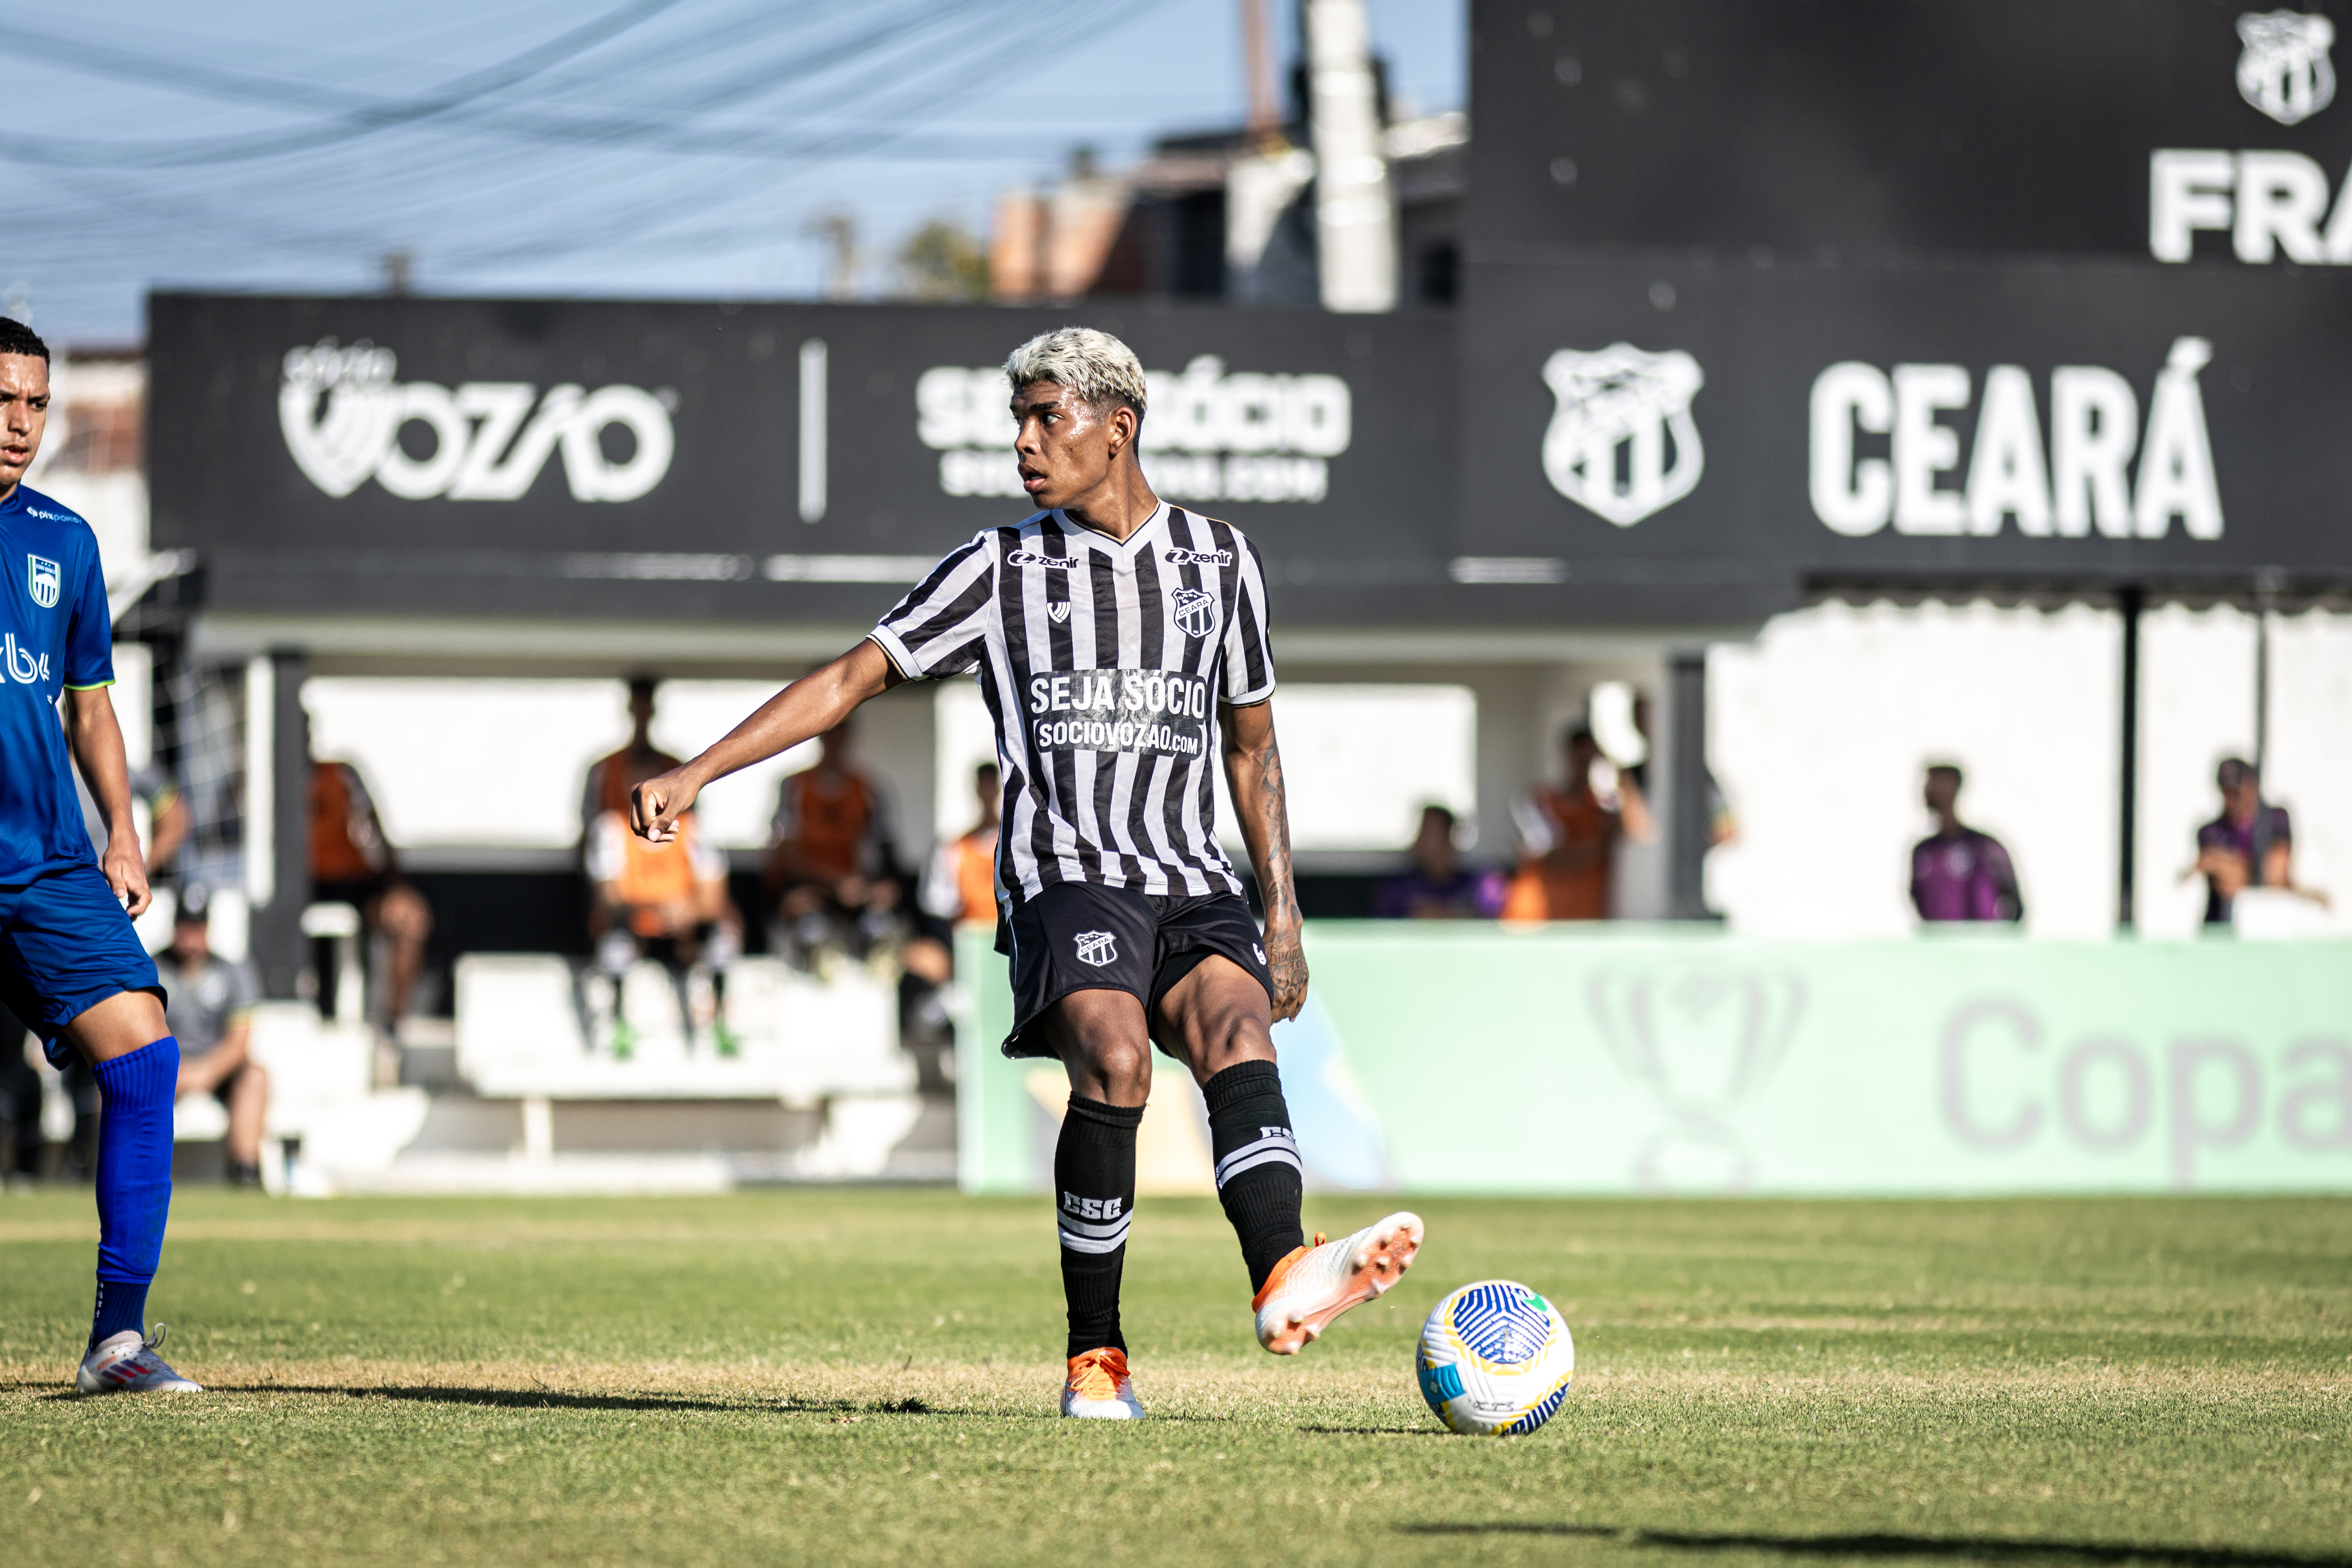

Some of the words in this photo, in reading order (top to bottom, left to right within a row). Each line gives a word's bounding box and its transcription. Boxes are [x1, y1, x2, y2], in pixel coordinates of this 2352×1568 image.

[1809, 335, 2224, 540] CEARÁ
[1038, 556, 1079, 568] zenir
[1191, 552, 1230, 564] zenir
[1178, 597, 1209, 616] CEARÁ
[1030, 676, 1116, 714] SEJA
[1124, 669, 1206, 719] SÓCIO
[1939, 997, 2352, 1194] Copa
